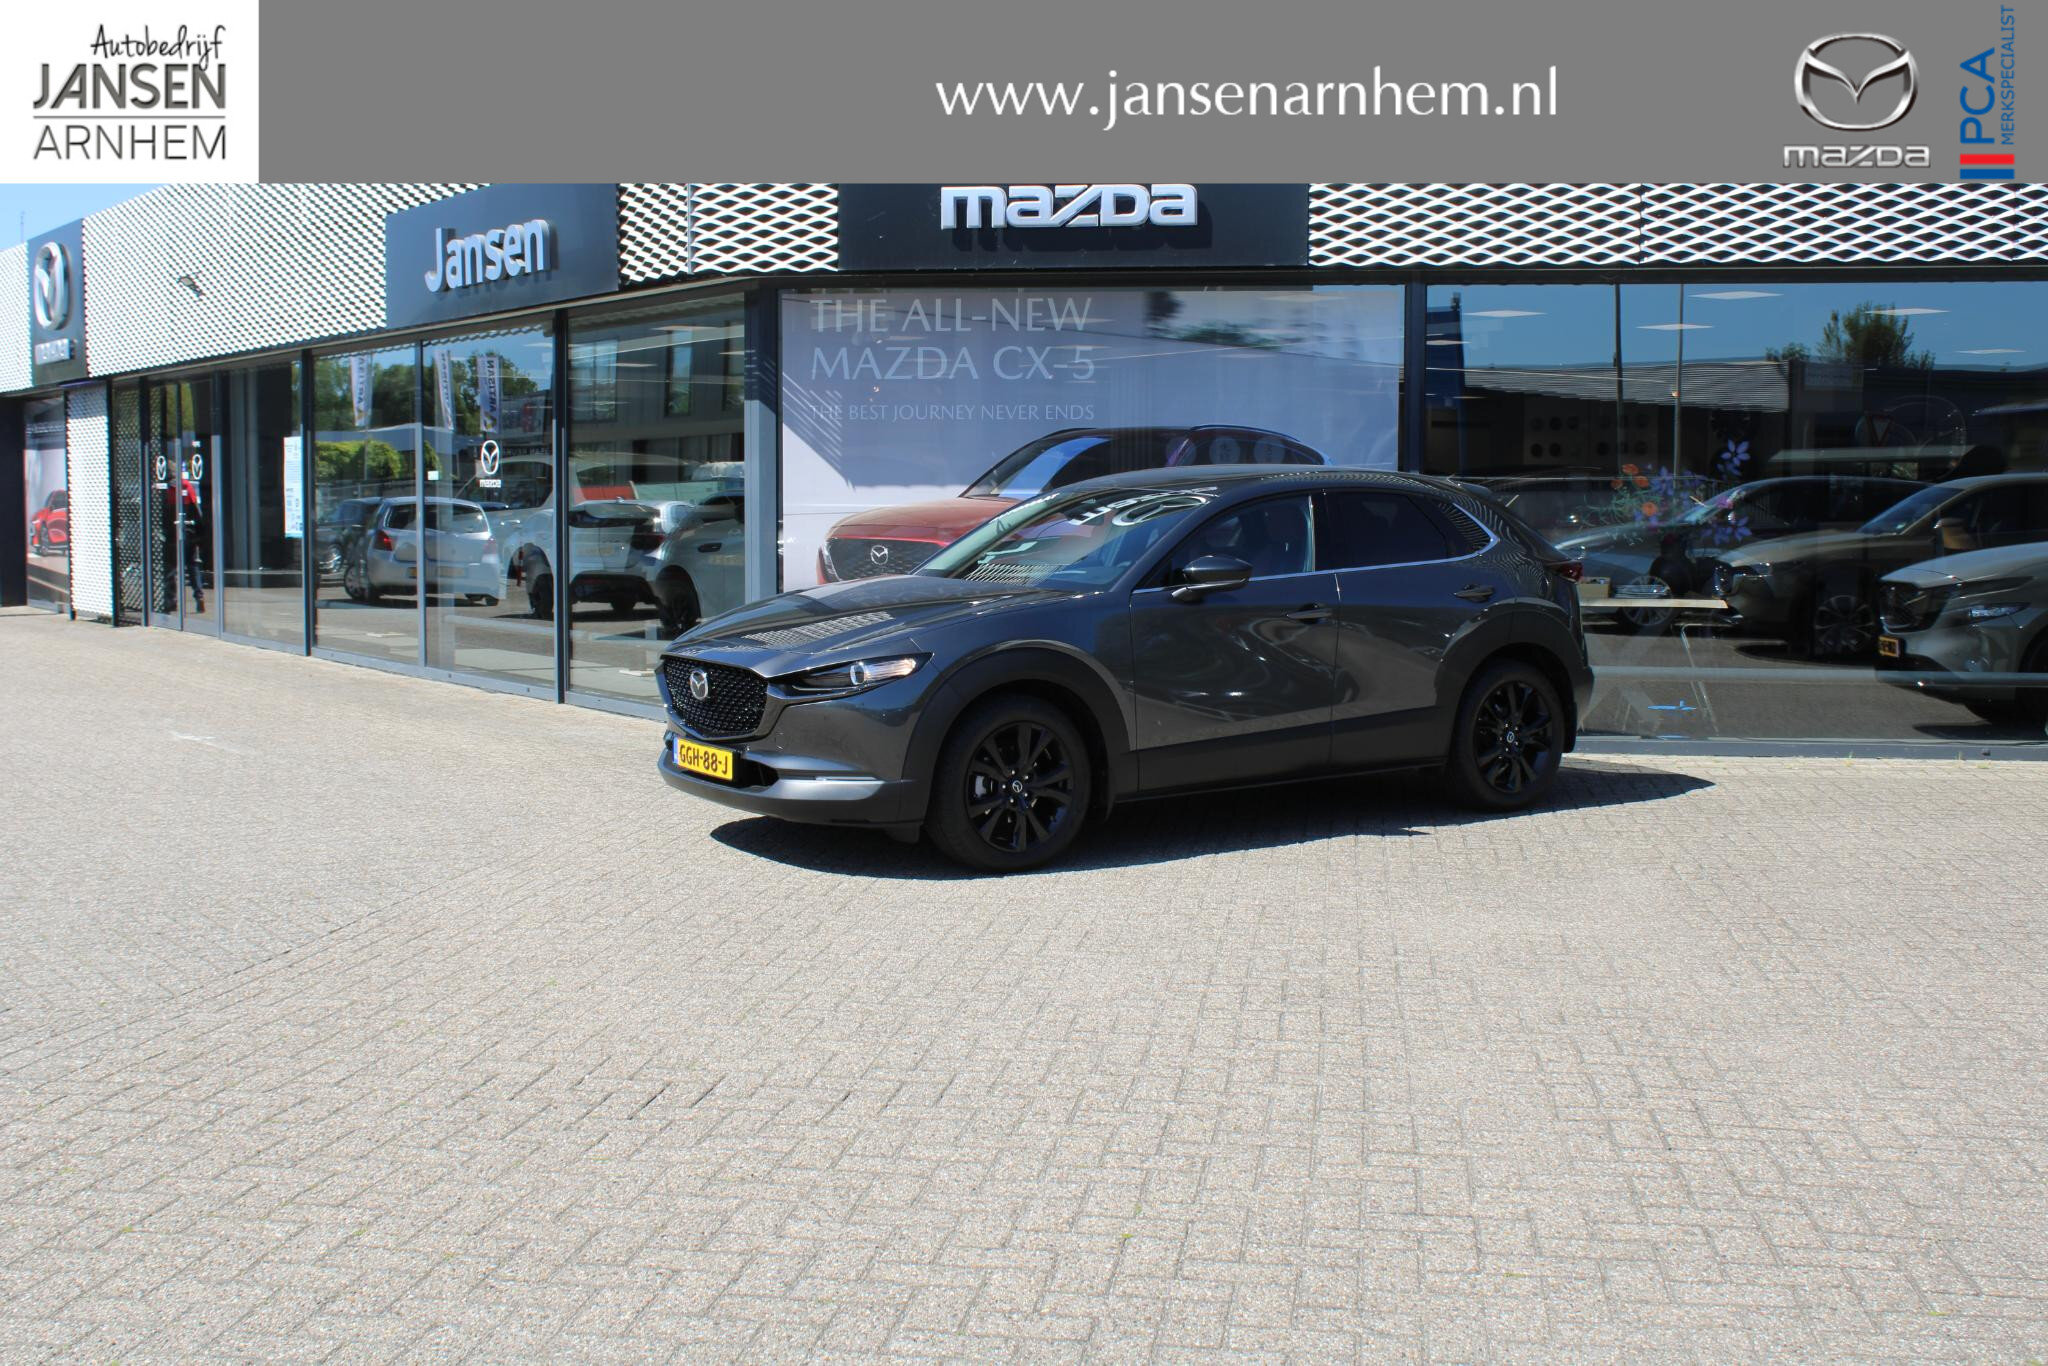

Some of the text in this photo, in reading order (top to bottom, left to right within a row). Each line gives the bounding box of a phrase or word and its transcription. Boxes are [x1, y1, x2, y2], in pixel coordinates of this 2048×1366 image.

[424, 219, 551, 293] Jansen
[810, 297, 1092, 333] THE ALL-NEW
[811, 345, 1096, 380] MAZDA CX-5
[811, 403, 1096, 422] THE BEST JOURNEY NEVER ENDS
[679, 744, 728, 775] GGH-88-J
